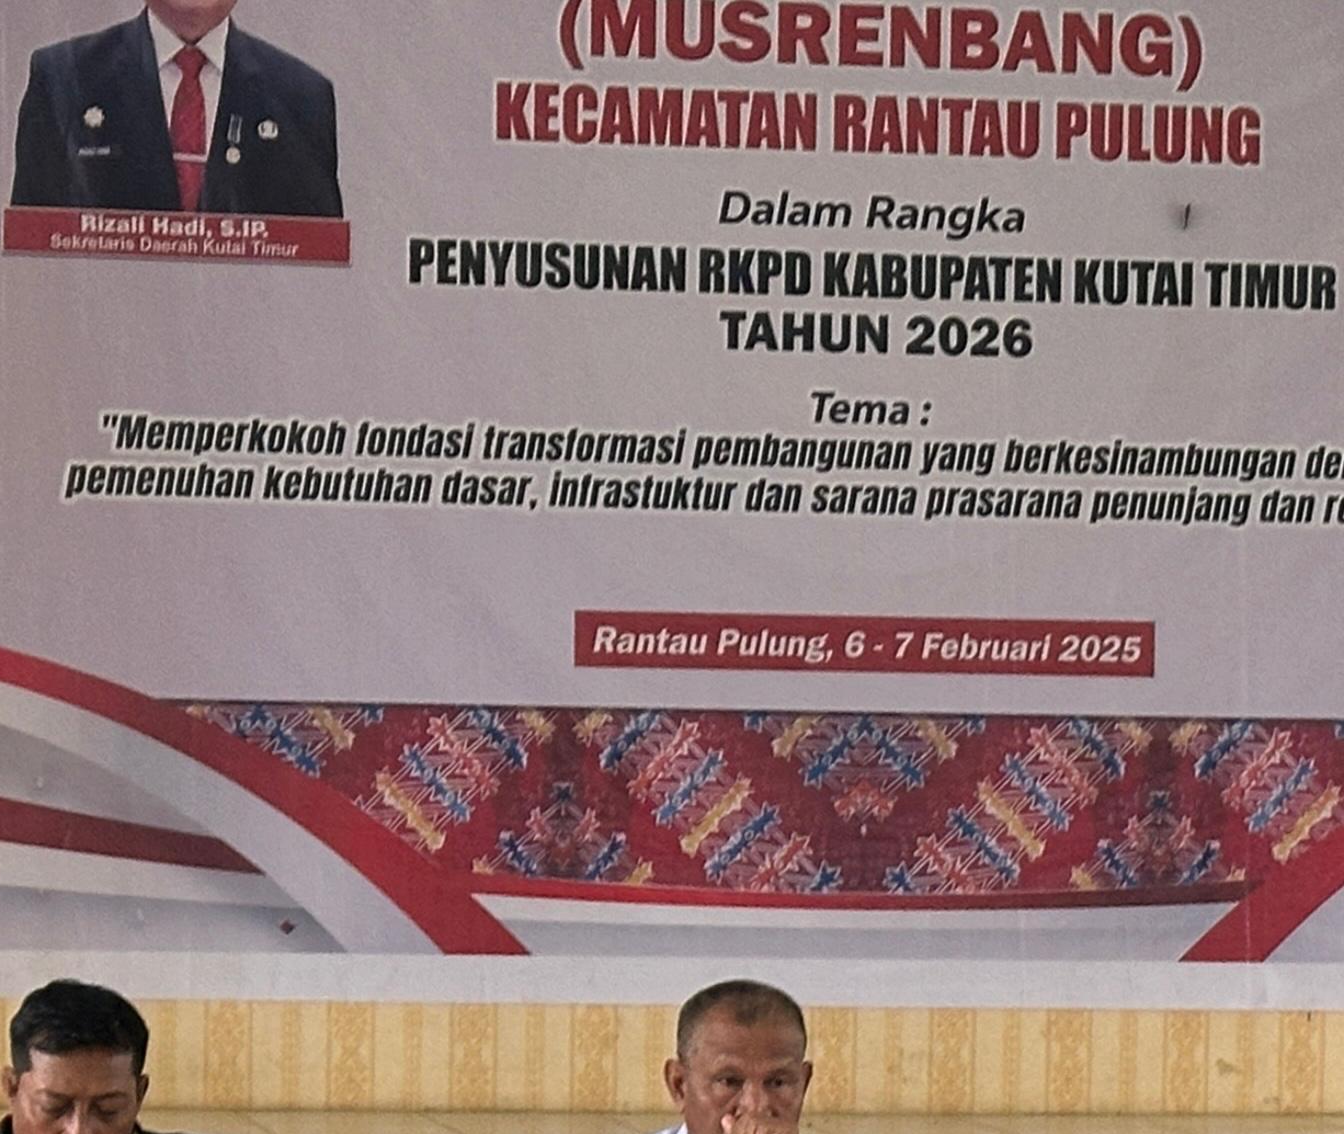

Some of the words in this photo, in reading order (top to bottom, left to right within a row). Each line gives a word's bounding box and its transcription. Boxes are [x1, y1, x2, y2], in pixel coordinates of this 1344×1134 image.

[560, 0, 1202, 92] (MUSRENBANG)
[496, 81, 818, 152] KECAMATAN
[833, 94, 1041, 160] RANTAU
[1055, 101, 1261, 167] PULUNG
[81, 213, 145, 233] Rizali
[153, 214, 212, 238] Hadi,
[718, 190, 852, 228] Dalam
[866, 195, 1026, 241] Rangka
[50, 233, 135, 250] Sekretaris
[139, 236, 198, 254] Daerah
[203, 236, 246, 255] Kutai
[251, 241, 300, 257] Timur
[408, 238, 687, 293] PENYUSUNAN
[698, 247, 812, 297] RKPD
[823, 251, 1062, 304] KABUPATEN
[1073, 258, 1194, 308] KUTAI
[1204, 262, 1337, 311] TIMUR
[719, 310, 889, 355] TAHUN
[905, 315, 1033, 359] 2026
[810, 391, 911, 426] Tema
[355, 421, 476, 460] fondasi
[483, 425, 687, 465] transformasi
[691, 433, 913, 474] pembangunan
[919, 442, 997, 477] yang
[1003, 439, 1297, 483] berkesinambungan
[64, 463, 255, 499] pemenuhan
[262, 465, 433, 504] kebutuhan
[441, 470, 538, 511] dasar,
[548, 471, 736, 511] infrastuktur
[744, 478, 803, 513] dan
[810, 484, 918, 516] sarana
[924, 487, 1083, 521] prasarana
[1089, 485, 1252, 527] penunjang
[1259, 489, 1316, 524] dan
[593, 625, 708, 655] Rantau
[717, 628, 833, 664] Pulung,
[844, 630, 866, 658] 6
[895, 632, 913, 659] 7
[921, 632, 1052, 662] Februari
[1058, 634, 1142, 663] 2025
